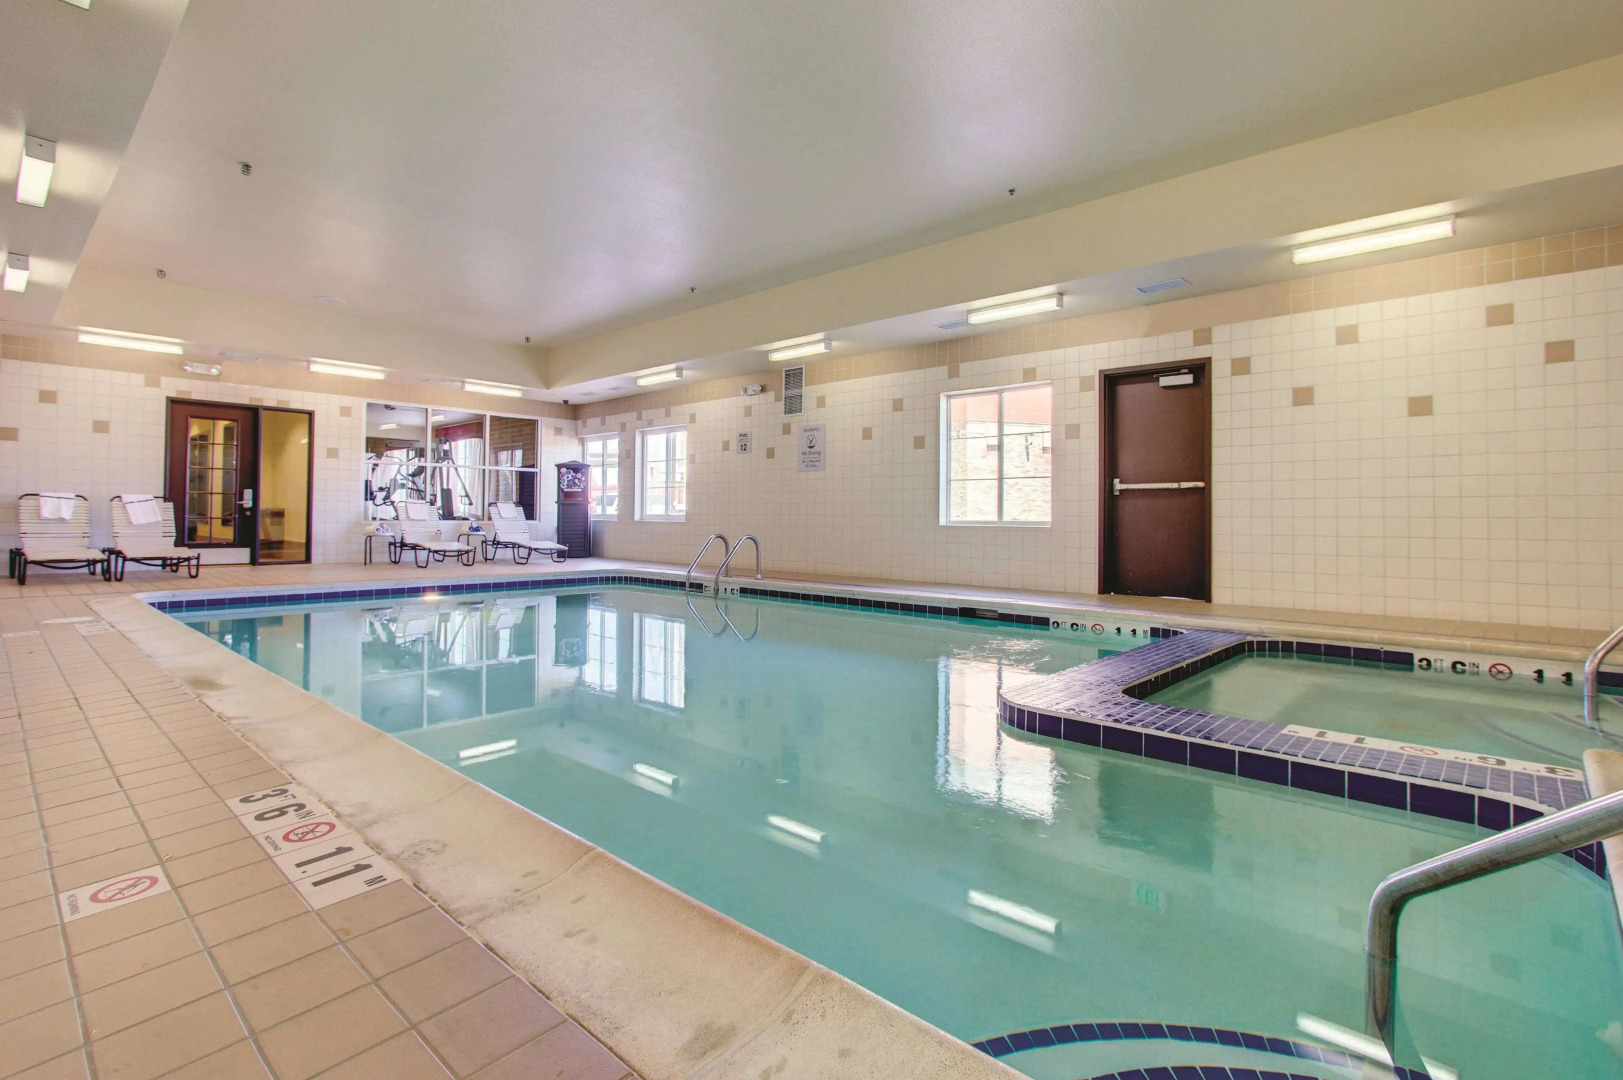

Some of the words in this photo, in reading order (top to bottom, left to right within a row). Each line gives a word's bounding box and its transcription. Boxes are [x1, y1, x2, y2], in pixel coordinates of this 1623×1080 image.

[740, 444, 748, 452] 12
[238, 788, 289, 804] 3
[254, 802, 306, 821] 6
[294, 809, 316, 820] IN
[363, 874, 388, 887] M
